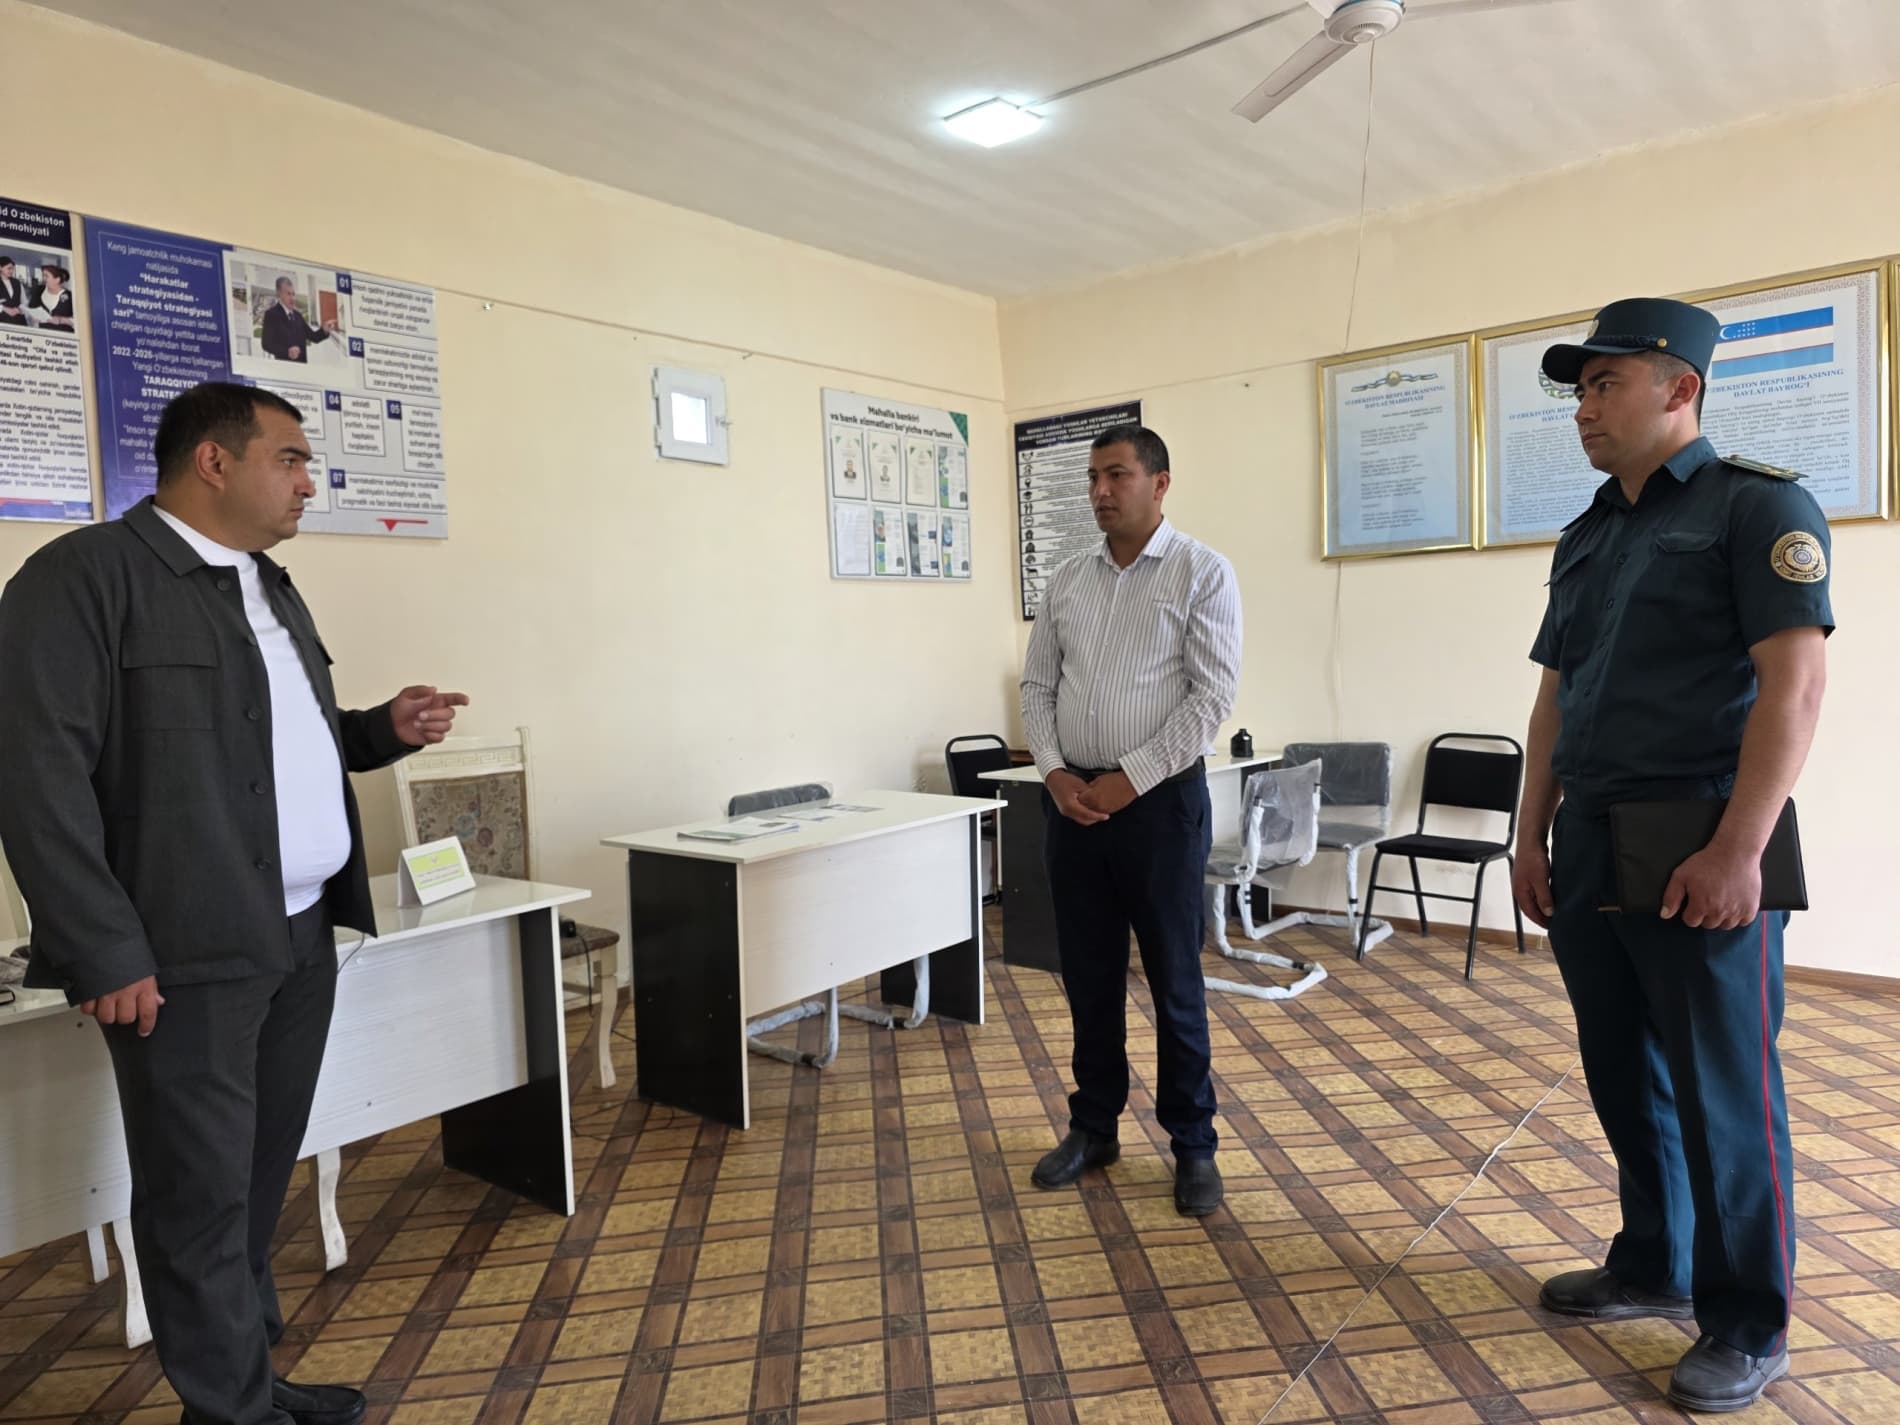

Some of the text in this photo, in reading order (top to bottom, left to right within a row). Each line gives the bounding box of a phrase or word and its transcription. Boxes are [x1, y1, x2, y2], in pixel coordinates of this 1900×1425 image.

[340, 276, 349, 288] 01
[129, 284, 194, 302] strategiyasidan
[116, 294, 212, 318] Taraqqiyot strategiyasi
[112, 346, 131, 356] 2022
[352, 341, 362, 352] 02
[1760, 369, 1844, 386] RESPUBLIKASINING
[1734, 388, 1766, 398] DAVLAT
[328, 395, 339, 405] 04
[840, 414, 858, 424] bank
[868, 406, 920, 422] Mahalla bankiri
[333, 472, 342, 483] 07
